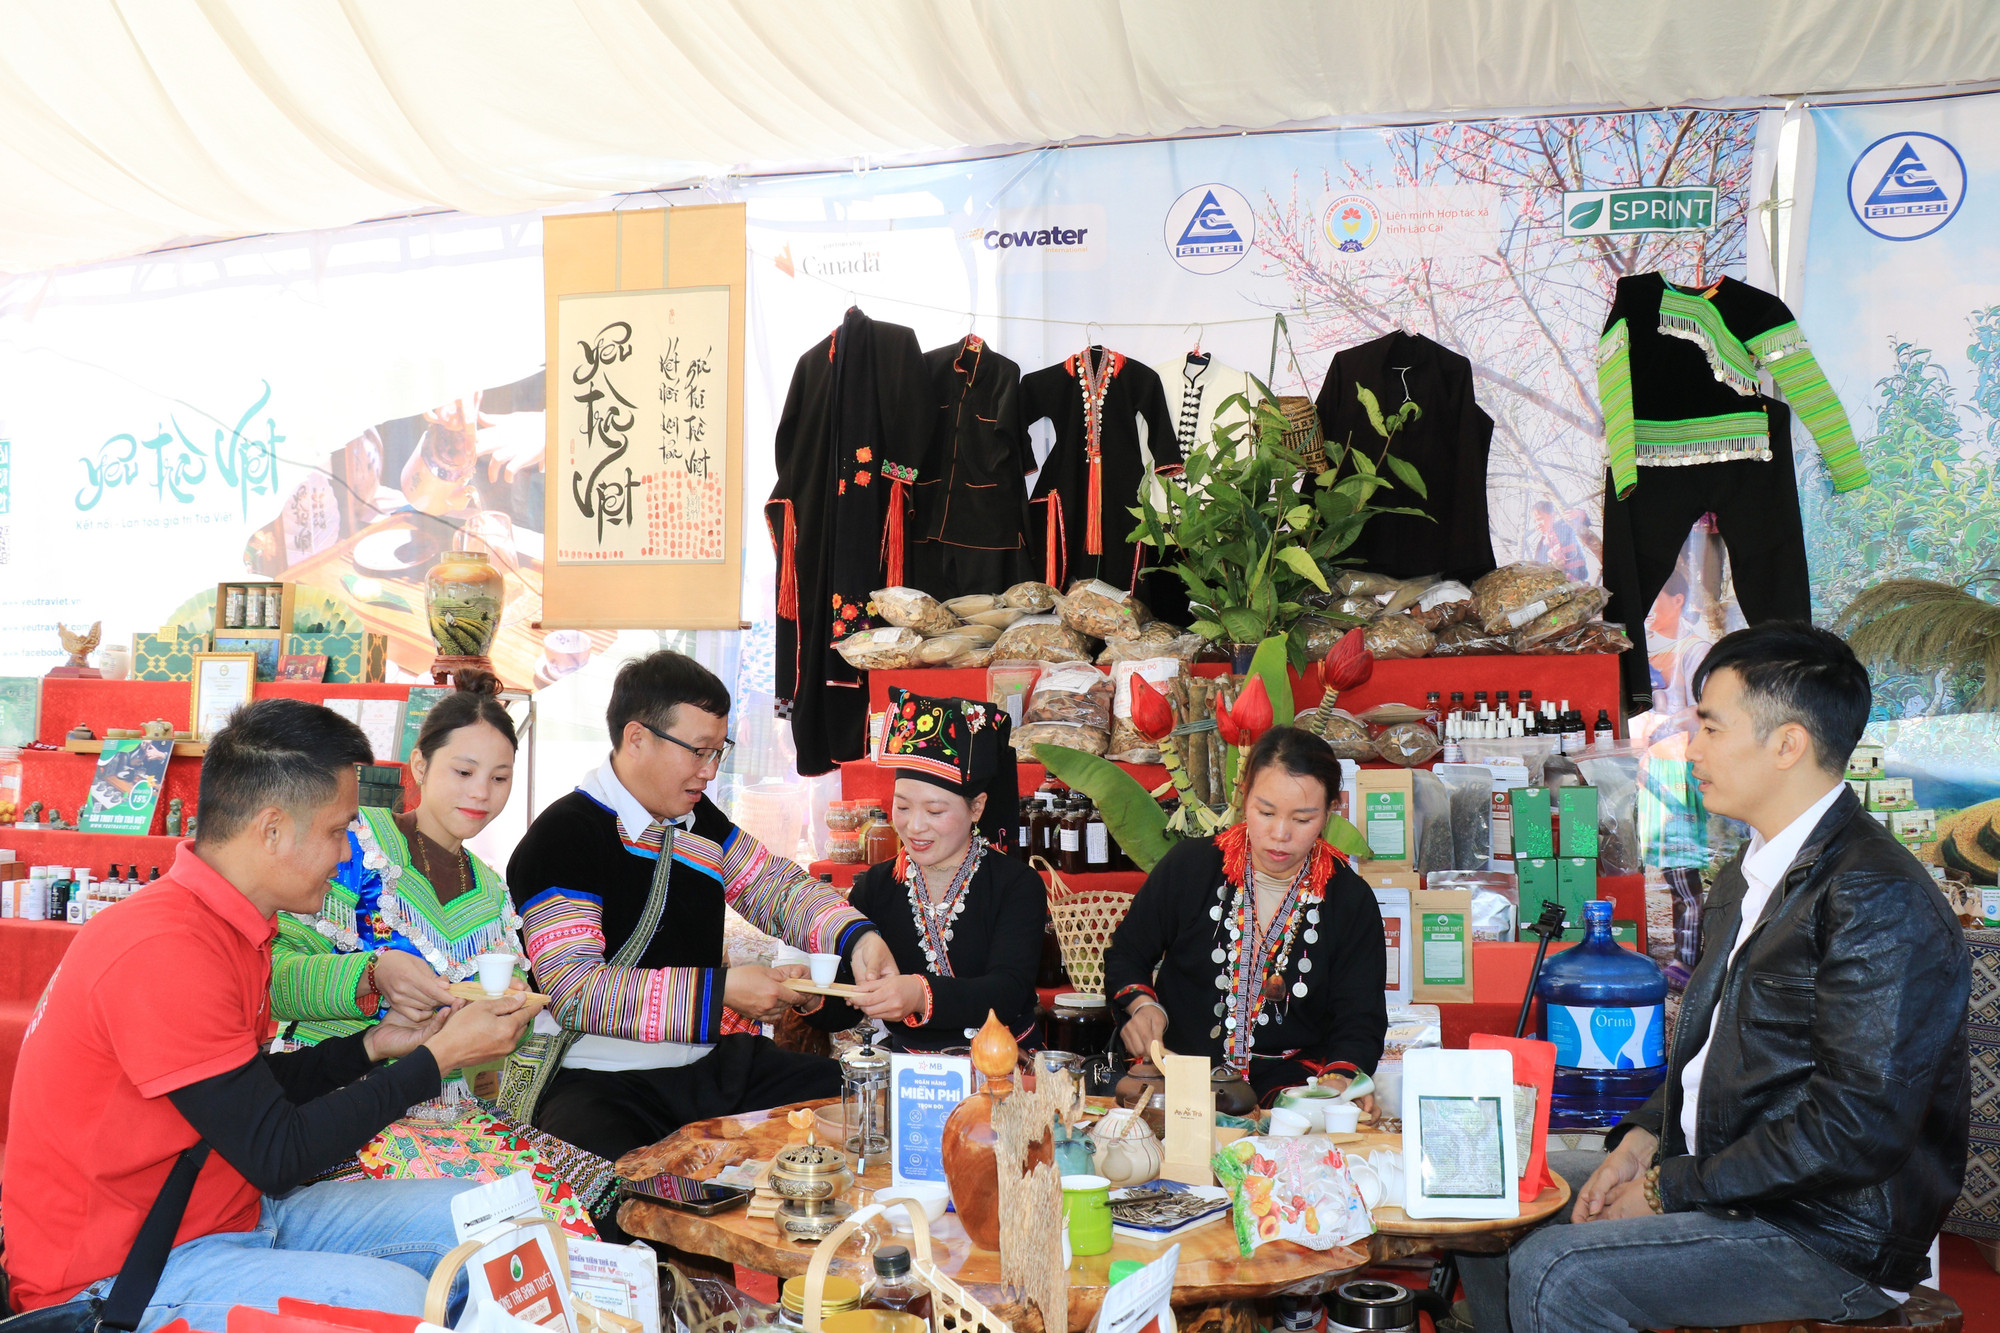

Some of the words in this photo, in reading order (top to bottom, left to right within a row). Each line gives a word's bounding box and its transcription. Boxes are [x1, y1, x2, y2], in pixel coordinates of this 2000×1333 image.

[1386, 211, 1407, 221] Liên
[1409, 210, 1435, 220] minh
[1437, 208, 1458, 219] Hợp
[1460, 208, 1475, 217] tác
[1477, 207, 1489, 217] xã
[1612, 199, 1711, 222] SPRINT
[984, 226, 1088, 250] Cowater
[802, 251, 880, 275] Canada
[1595, 1014, 1632, 1027] Orina
[900, 1085, 935, 1100] MIỄN
[937, 1087, 961, 1102] PHÍ
